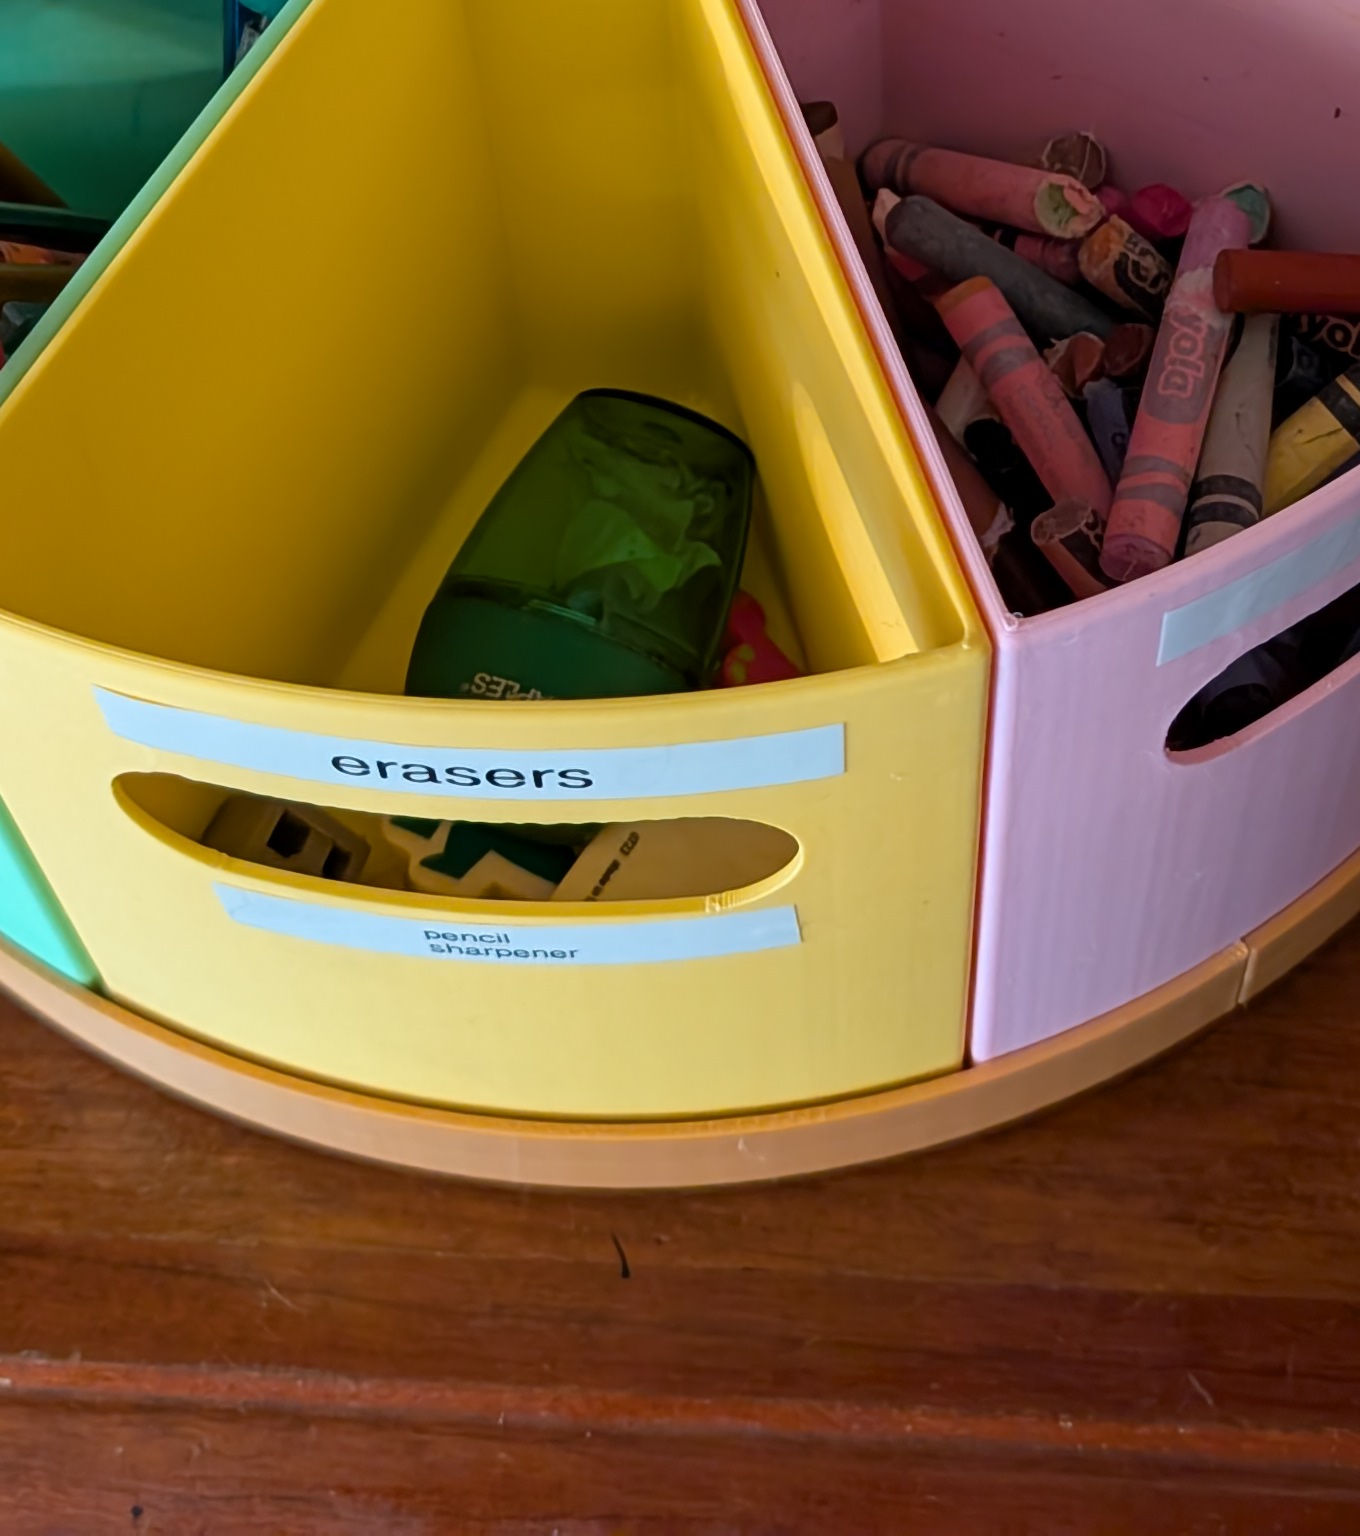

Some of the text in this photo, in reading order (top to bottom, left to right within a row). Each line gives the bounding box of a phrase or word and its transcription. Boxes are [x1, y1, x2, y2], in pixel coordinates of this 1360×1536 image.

[331, 755, 593, 789] erasers
[423, 930, 511, 944] pencil
[429, 943, 579, 959] sharpener
